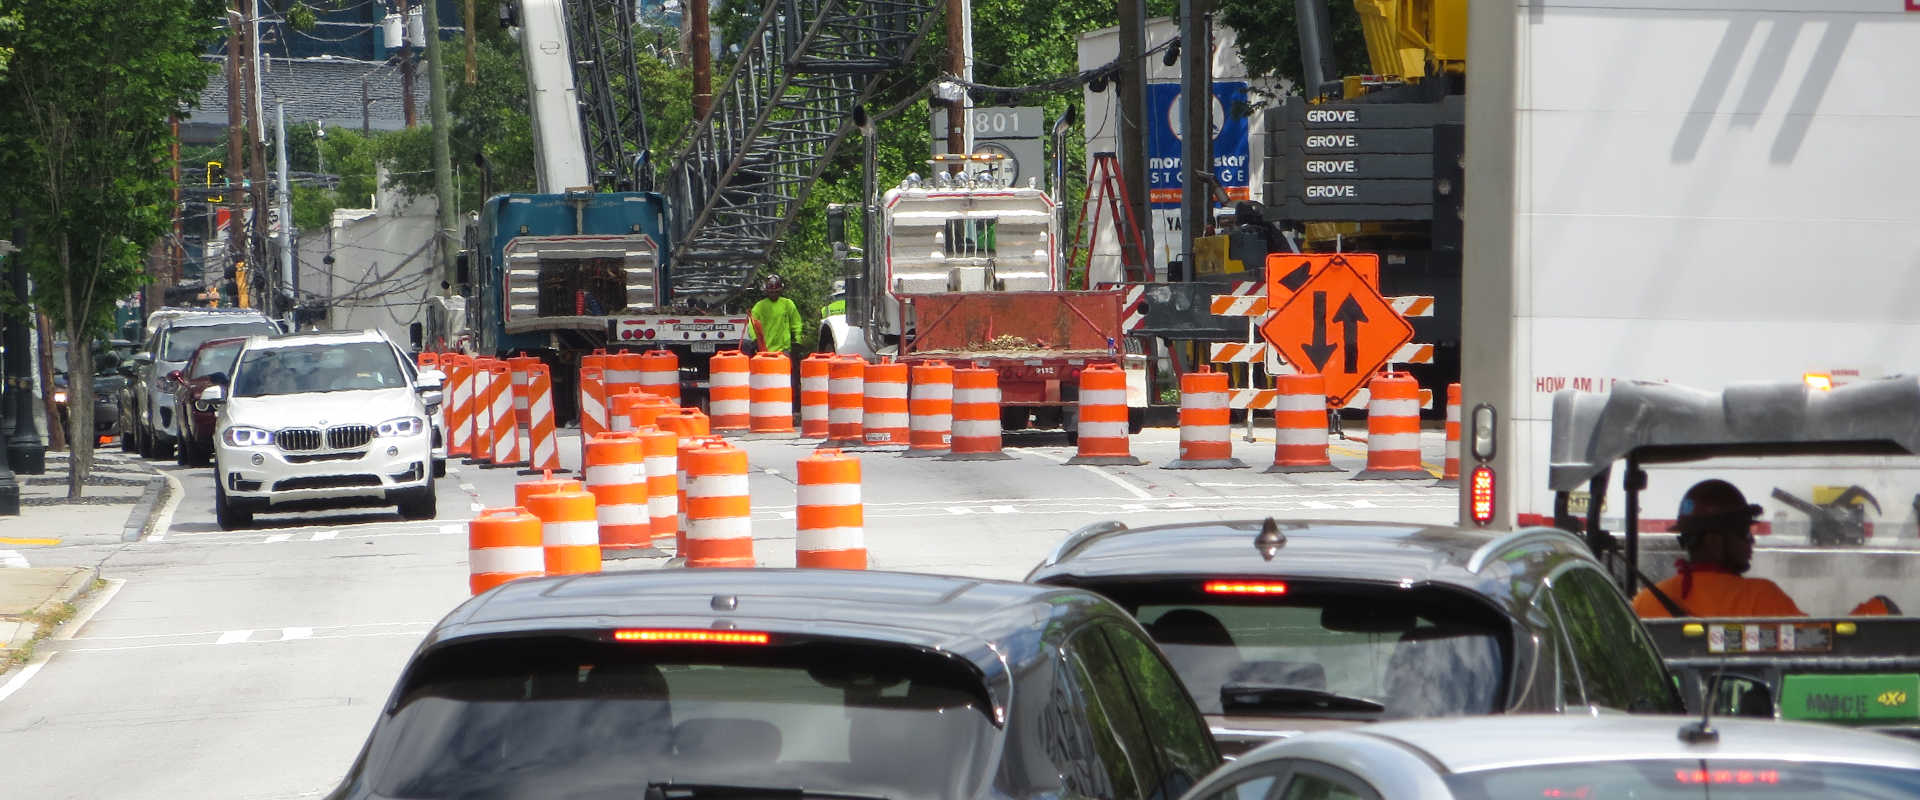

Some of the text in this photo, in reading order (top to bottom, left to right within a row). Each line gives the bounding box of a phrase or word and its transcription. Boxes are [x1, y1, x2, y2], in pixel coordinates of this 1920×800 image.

[975, 112, 1019, 132] 801
[1536, 377, 1565, 393] HOW
[1573, 377, 1592, 393] AM
